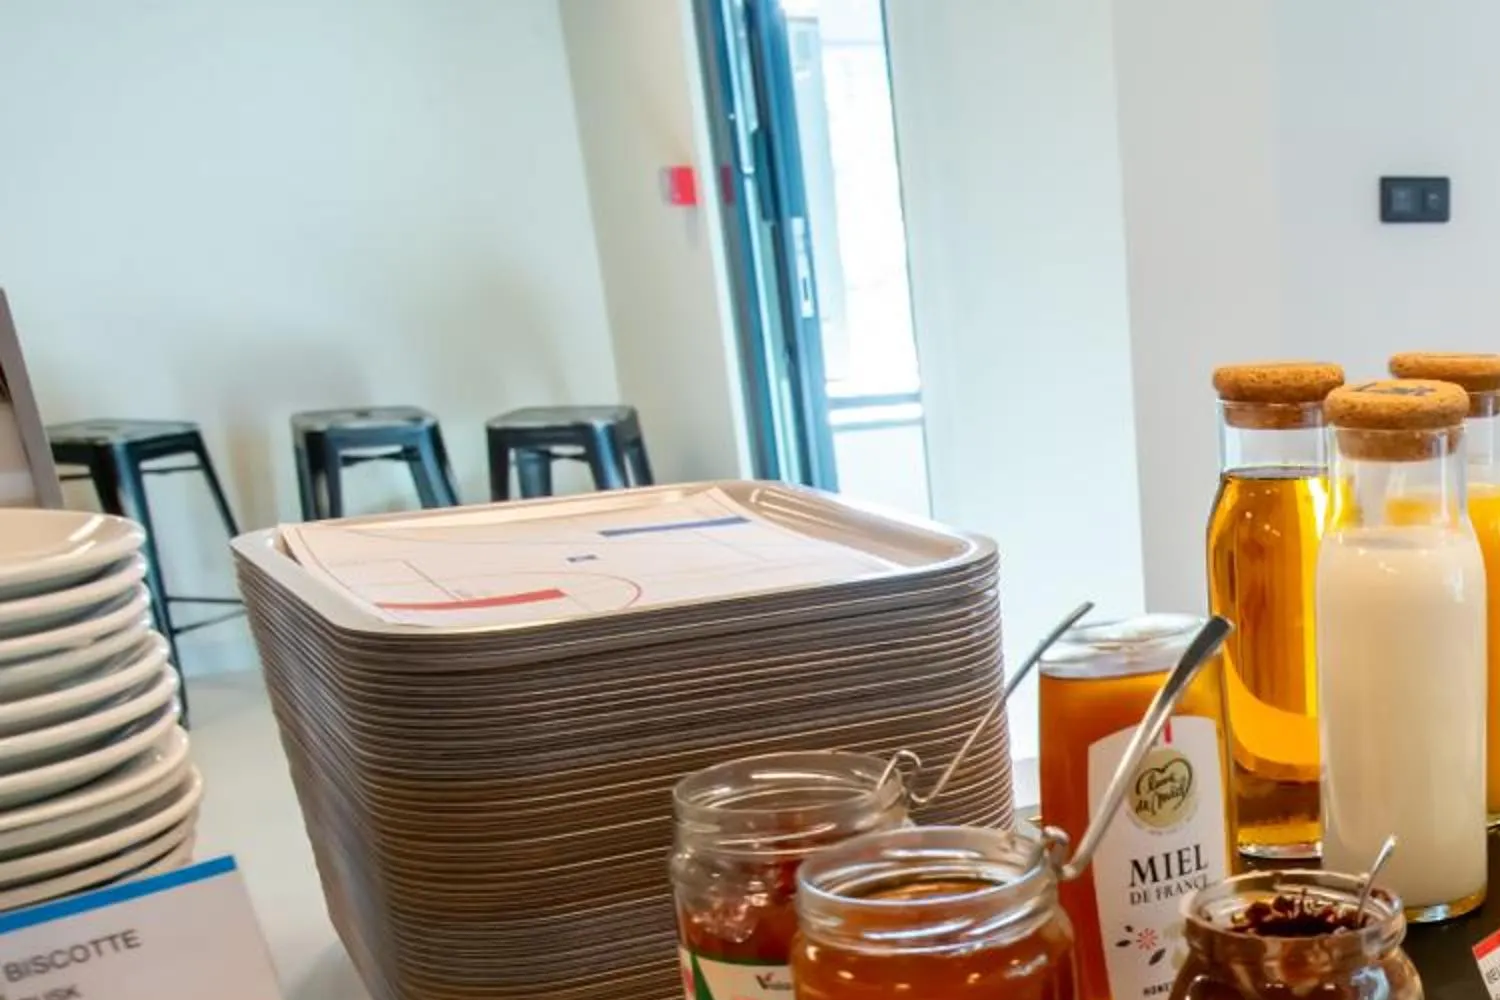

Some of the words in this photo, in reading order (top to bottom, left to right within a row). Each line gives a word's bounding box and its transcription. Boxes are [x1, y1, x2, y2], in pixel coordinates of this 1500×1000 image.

[1128, 843, 1209, 888] MIEL
[1129, 889, 1150, 906] DE
[3, 928, 142, 982] BISCOTTE
